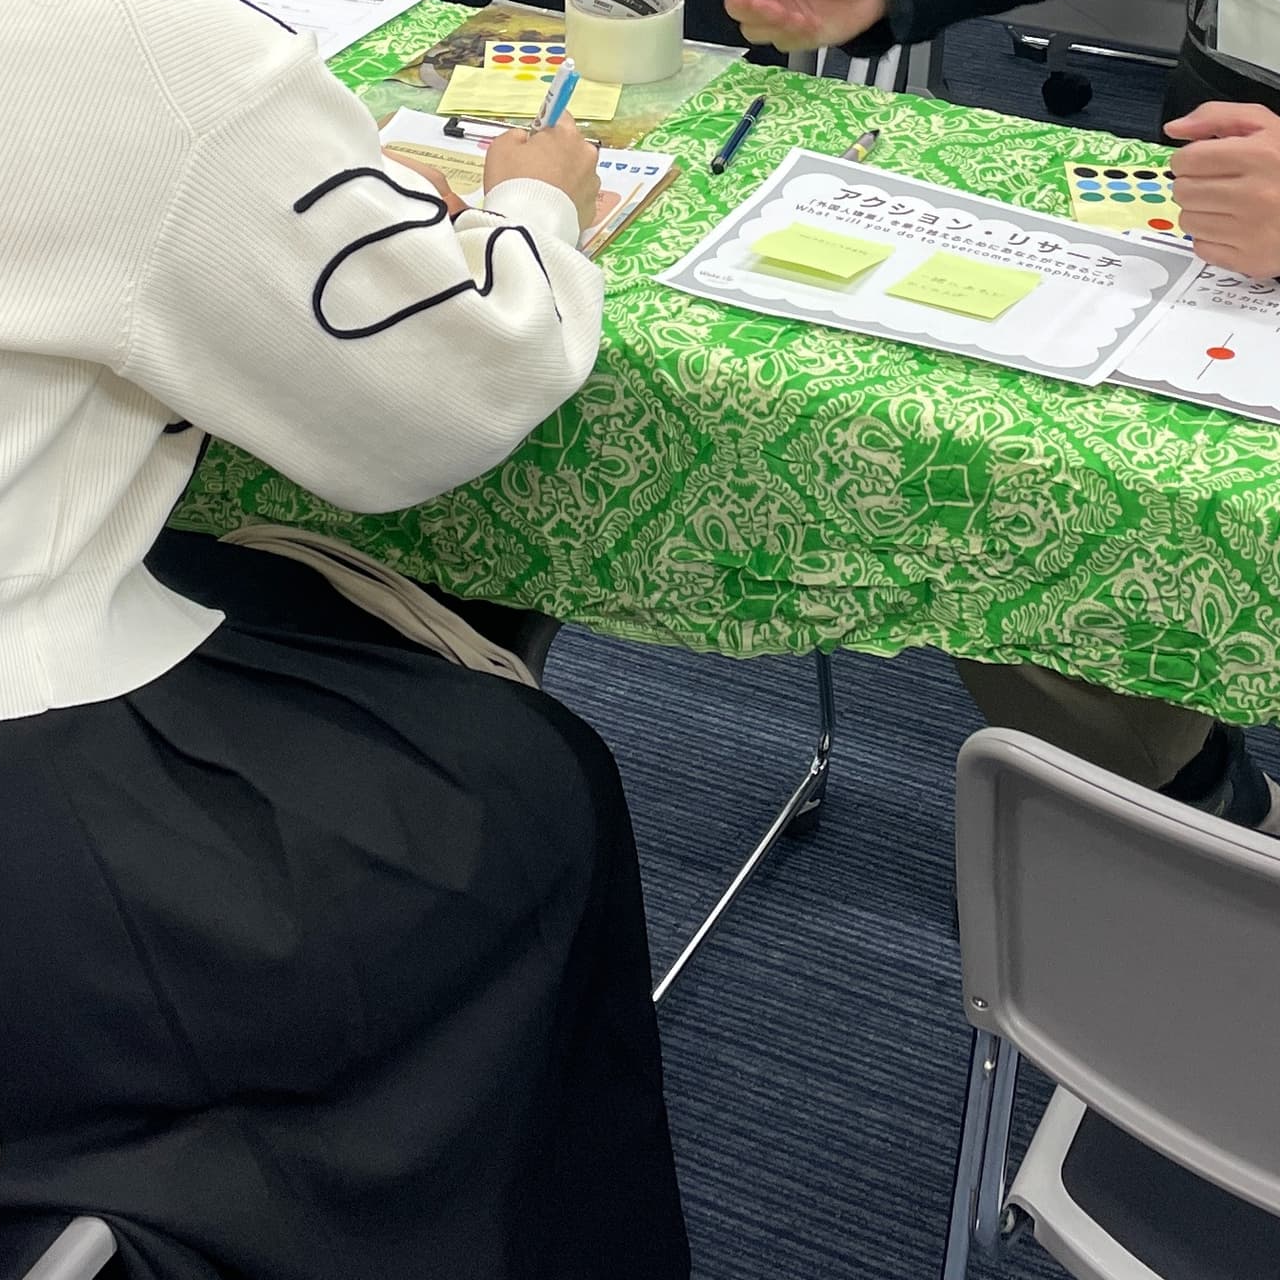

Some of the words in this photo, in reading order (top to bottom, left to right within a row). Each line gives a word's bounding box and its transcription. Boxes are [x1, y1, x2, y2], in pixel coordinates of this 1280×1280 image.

[795, 204, 830, 217] What
[835, 214, 862, 225] will
[864, 223, 891, 234] you
[897, 230, 914, 239] do
[921, 237, 935, 245] to
[941, 242, 1011, 263] overcome
[833, 188, 1123, 268] アクション・リサーチ
[1212, 296, 1233, 306] Do
[1239, 304, 1268, 314] you
